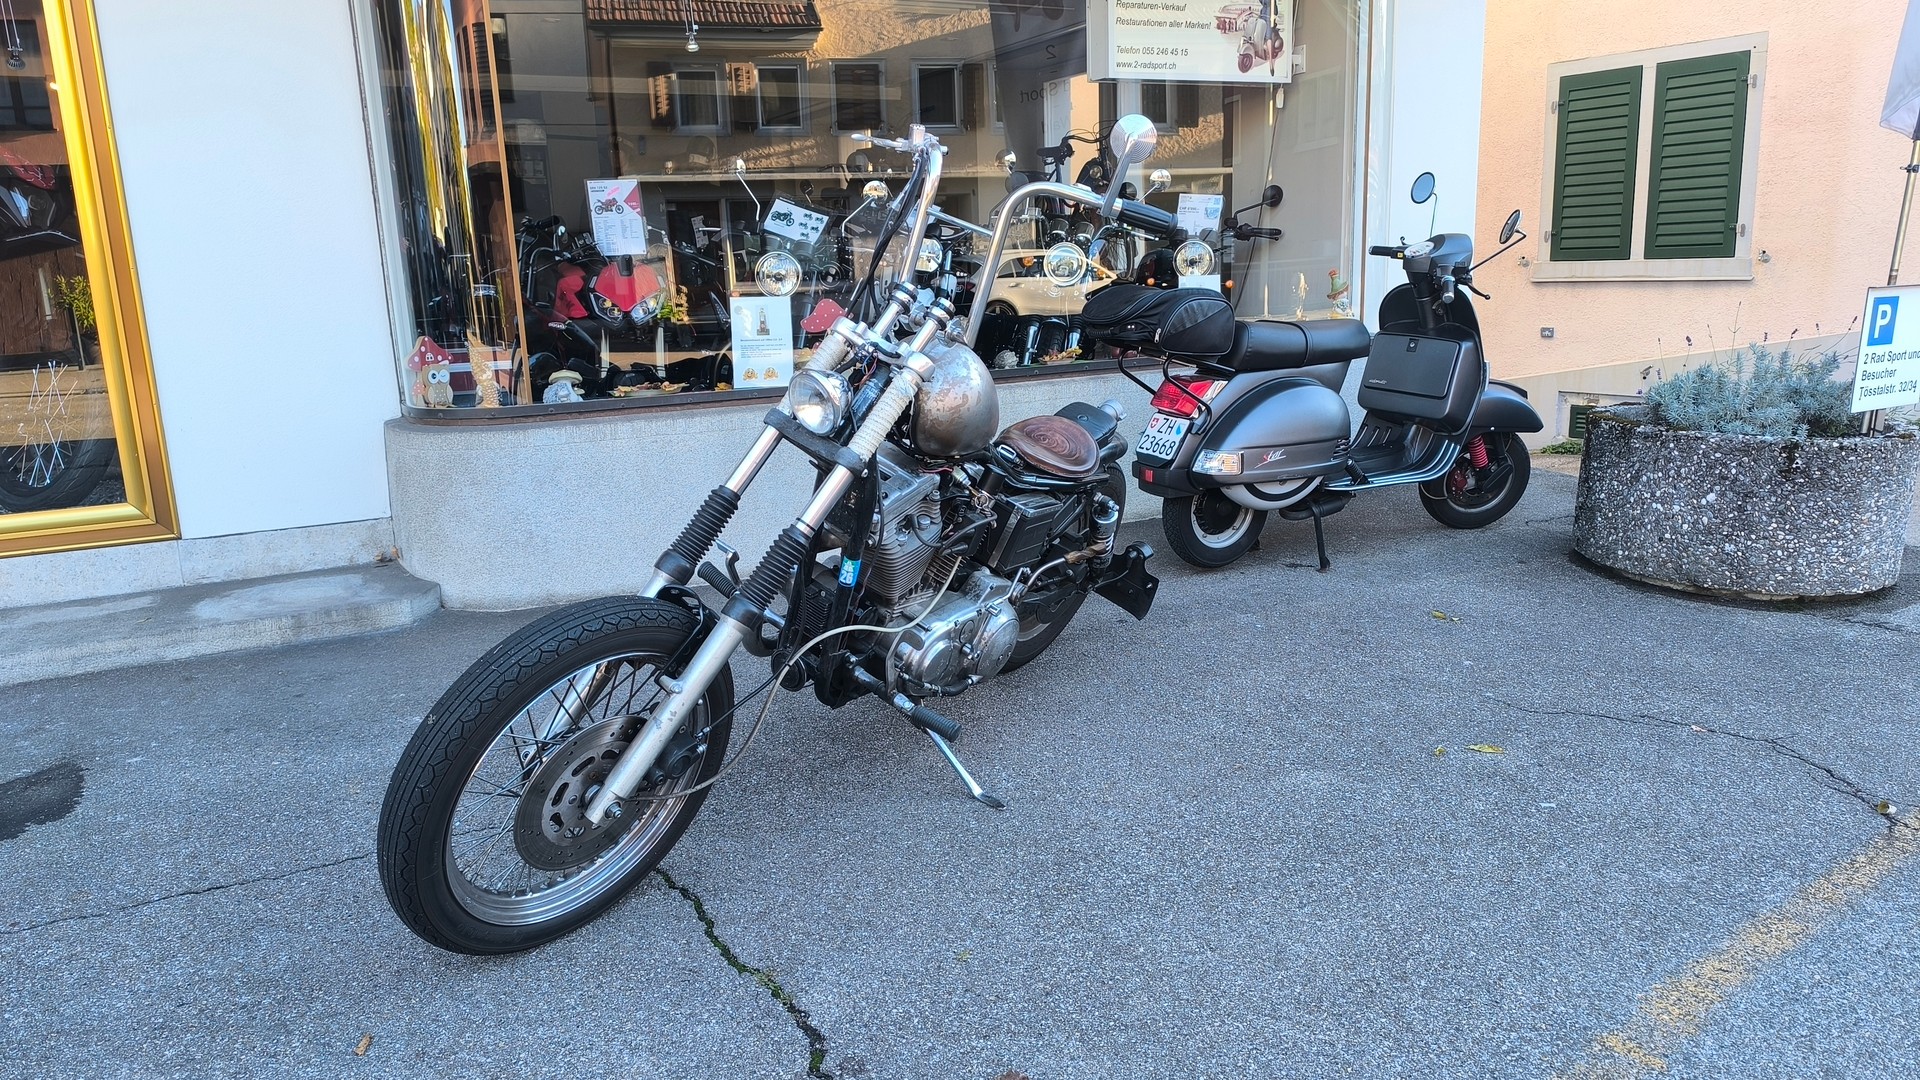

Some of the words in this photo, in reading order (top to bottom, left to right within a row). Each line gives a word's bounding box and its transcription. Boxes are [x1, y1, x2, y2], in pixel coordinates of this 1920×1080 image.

[1116, 0, 1187, 12] Reparaturen-Verkauf
[1116, 17, 1168, 28] Restaurationen
[1169, 19, 1184, 28] aller
[1185, 20, 1212, 30] Marken!
[1116, 45, 1141, 55] Telefon
[1142, 46, 1155, 56] 055
[1156, 47, 1169, 56] 246
[1170, 48, 1180, 56] 45
[1180, 48, 1189, 57] 15
[1116, 60, 1177, 71] www.2-radsport.ch
[1873, 303, 1892, 339] P
[1863, 353, 1869, 365] 2
[1870, 351, 1886, 364] Rad
[1887, 350, 1907, 364] Sport
[1861, 368, 1897, 381] Besucher
[1859, 383, 1896, 401] Tösstalstr.
[1898, 379, 1918, 393] 32/34
[1157, 417, 1178, 436] ZH
[1139, 435, 1176, 456] 23668
[839, 570, 854, 584] 26
